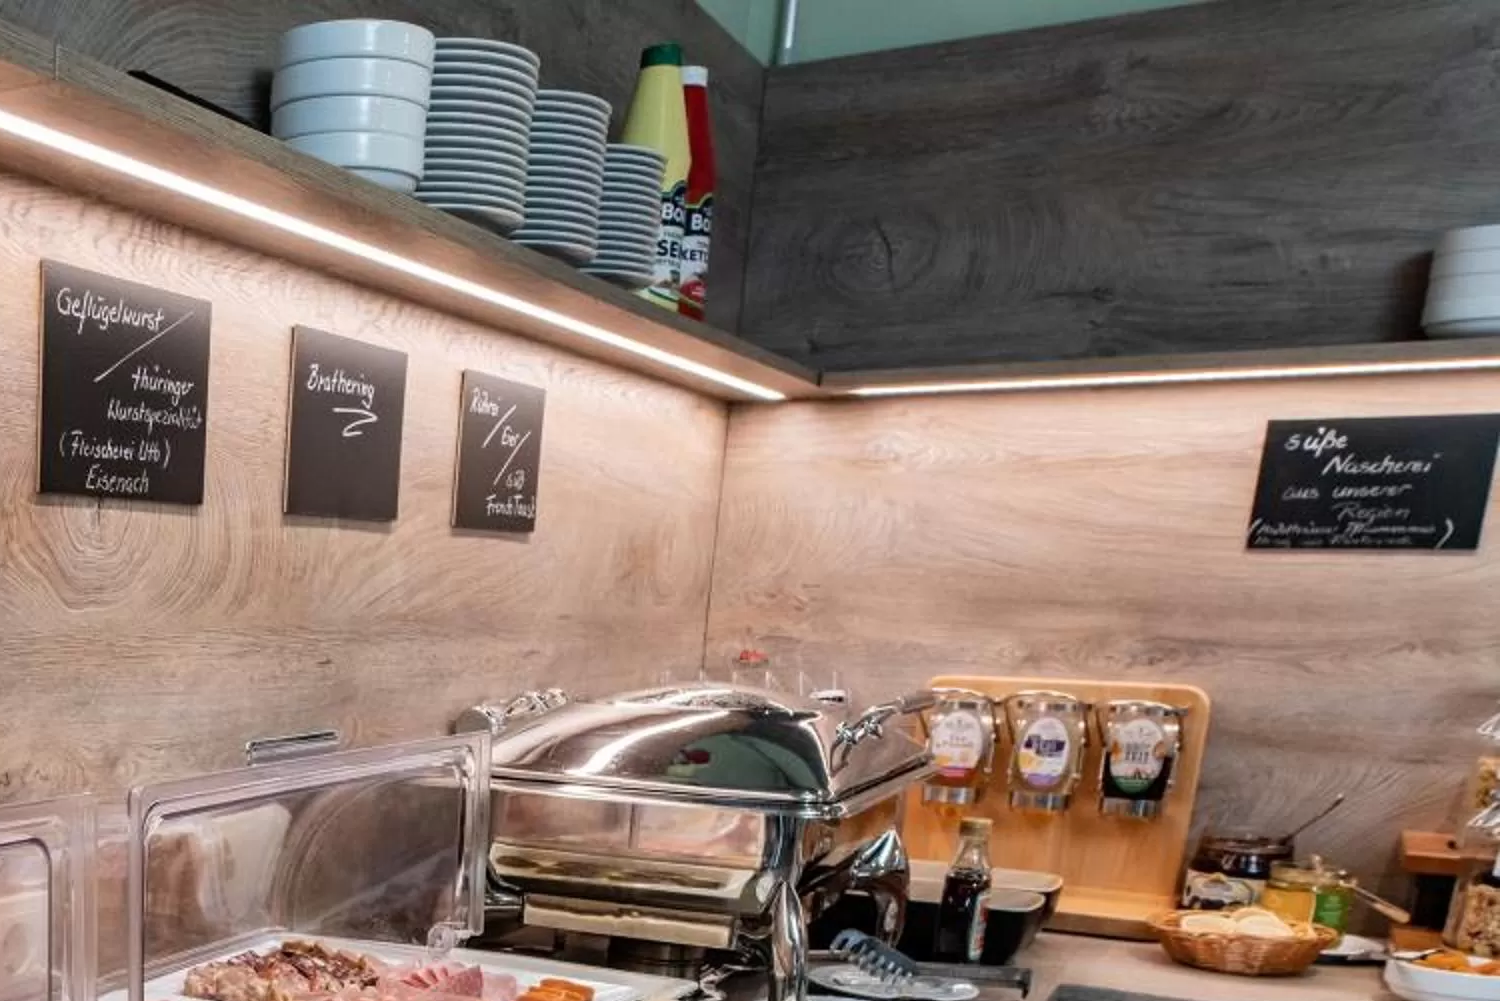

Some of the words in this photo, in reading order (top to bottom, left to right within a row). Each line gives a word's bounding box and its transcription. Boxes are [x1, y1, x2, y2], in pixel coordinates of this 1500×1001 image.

[56, 287, 165, 335] Geflügelwurst
[307, 363, 376, 409] Brathering
[1284, 427, 1349, 458] süße
[85, 463, 150, 493] Eisenach
[1320, 452, 1442, 476] Nascherei
[1282, 485, 1320, 500] aus
